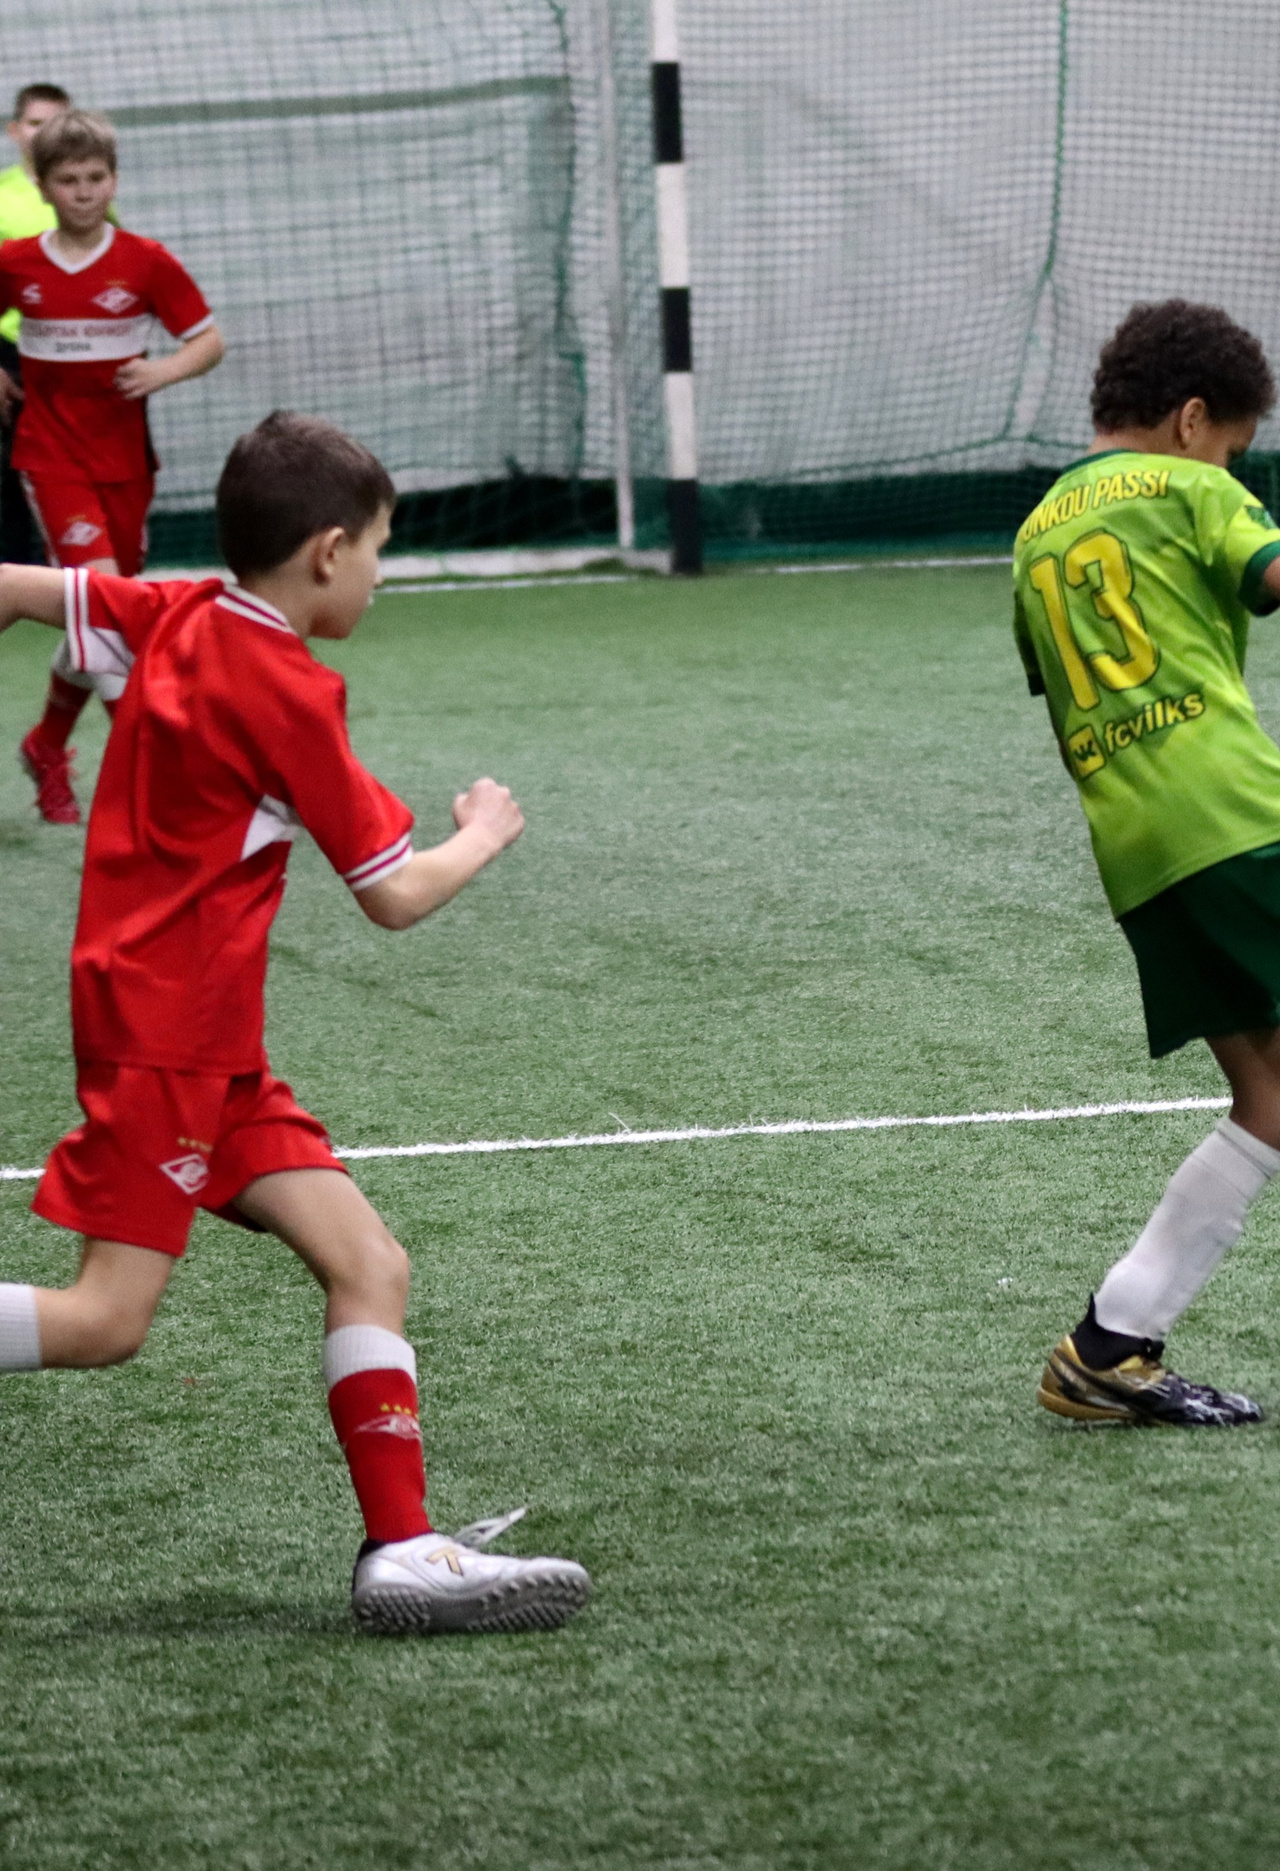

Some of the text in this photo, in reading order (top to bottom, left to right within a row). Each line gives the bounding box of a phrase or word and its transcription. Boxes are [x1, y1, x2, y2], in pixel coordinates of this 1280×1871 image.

[1092, 470, 1169, 509] PASSI
[1028, 527, 1160, 711] 13
[1104, 692, 1206, 754] fcvilks
